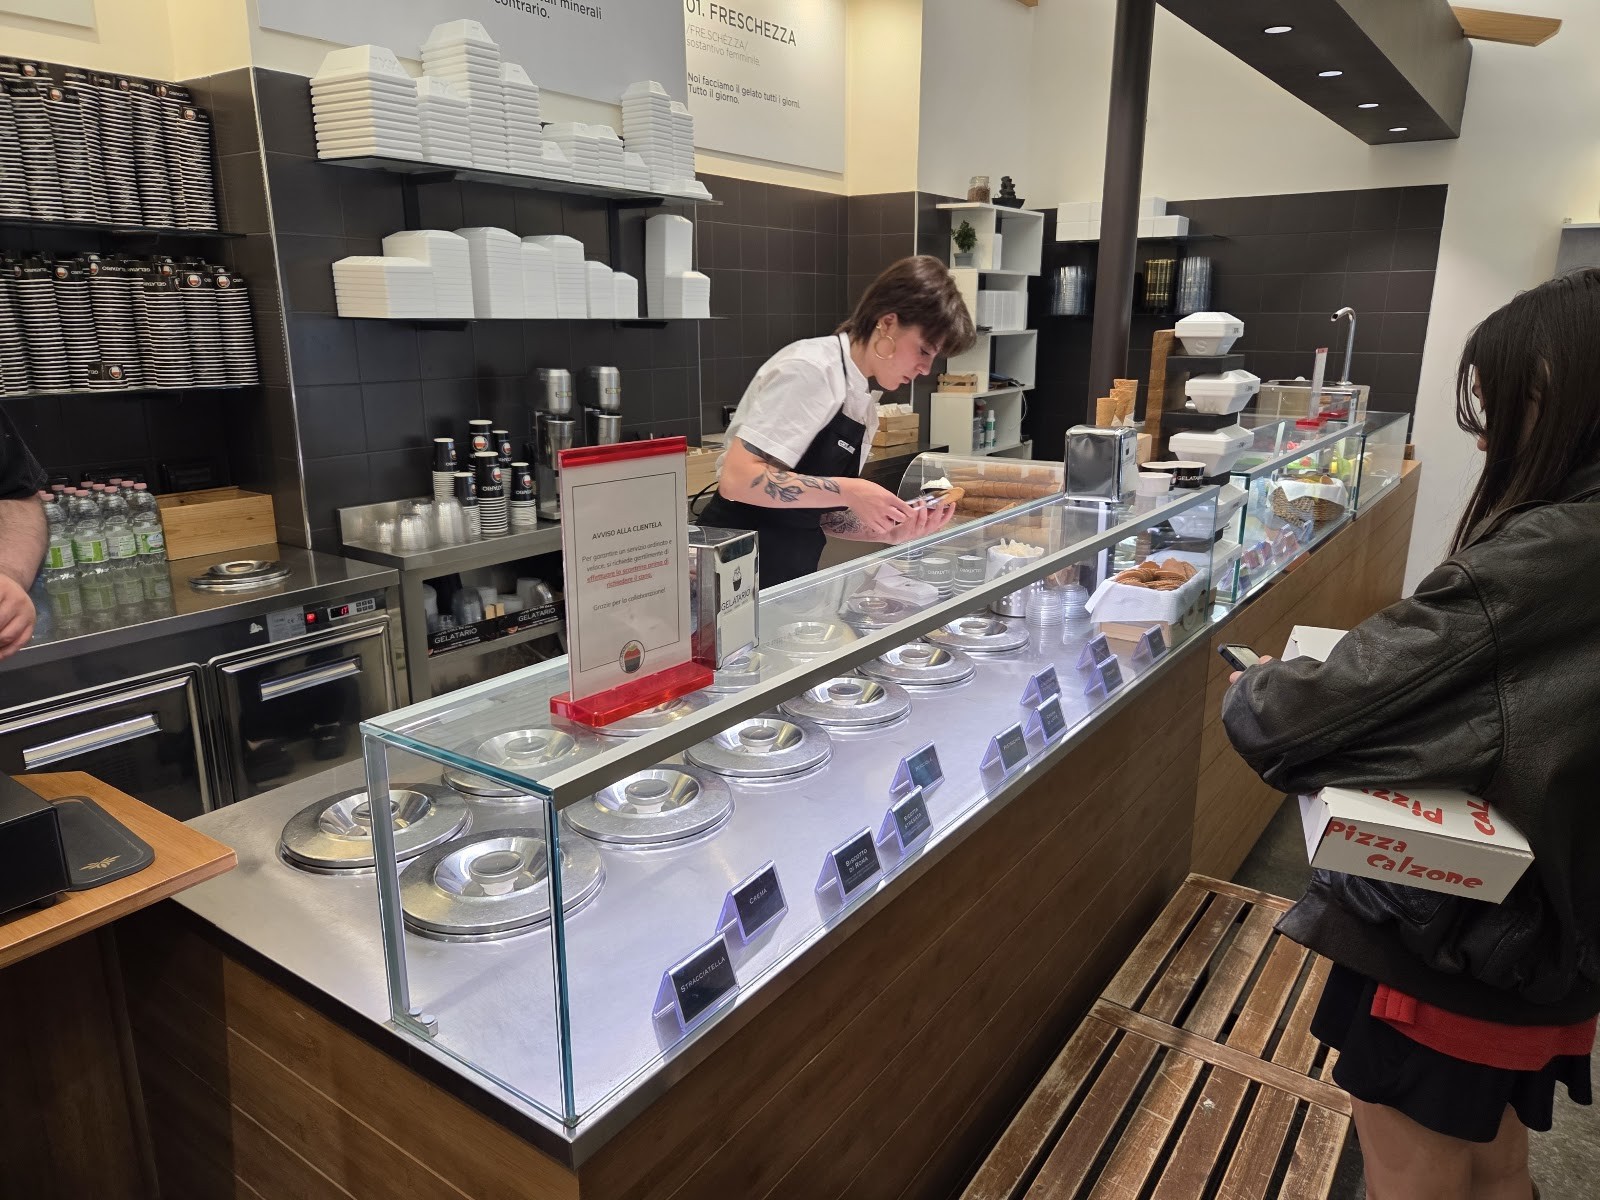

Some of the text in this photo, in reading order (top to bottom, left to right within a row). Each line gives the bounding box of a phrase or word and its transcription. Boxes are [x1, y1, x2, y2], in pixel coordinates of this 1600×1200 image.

[560, 0, 602, 19] minerali
[710, 3, 797, 46] FRESCHEZZA
[686, 38, 725, 56] sostantivo
[688, 72, 701, 83] Noi
[702, 76, 734, 91] facciamo
[742, 87, 762, 98] gelato
[763, 92, 777, 102] tutti
[688, 84, 708, 96] Tutto
[1195, 340, 1207, 353] S
[592, 521, 662, 540] AVVISO ALLA CLIENTELA
[593, 551, 618, 561] garantire
[627, 544, 646, 553] servizio
[612, 557, 634, 566] richiede
[634, 551, 663, 563] gentilmente
[586, 570, 615, 583] effettuare
[593, 601, 611, 611] Grazie
[612, 599, 621, 607] per
[628, 587, 666, 602] collaborazione!
[722, 588, 751, 611] GELATARIO
[518, 607, 556, 622] GELATARIO
[434, 627, 477, 644] GELATARIO
[1466, 800, 1496, 836] CAL
[1325, 820, 1408, 853] Pizza
[1367, 853, 1484, 889] Calzone
[749, 887, 768, 905] CREMA
[680, 956, 726, 993] STRACCIATELLA
